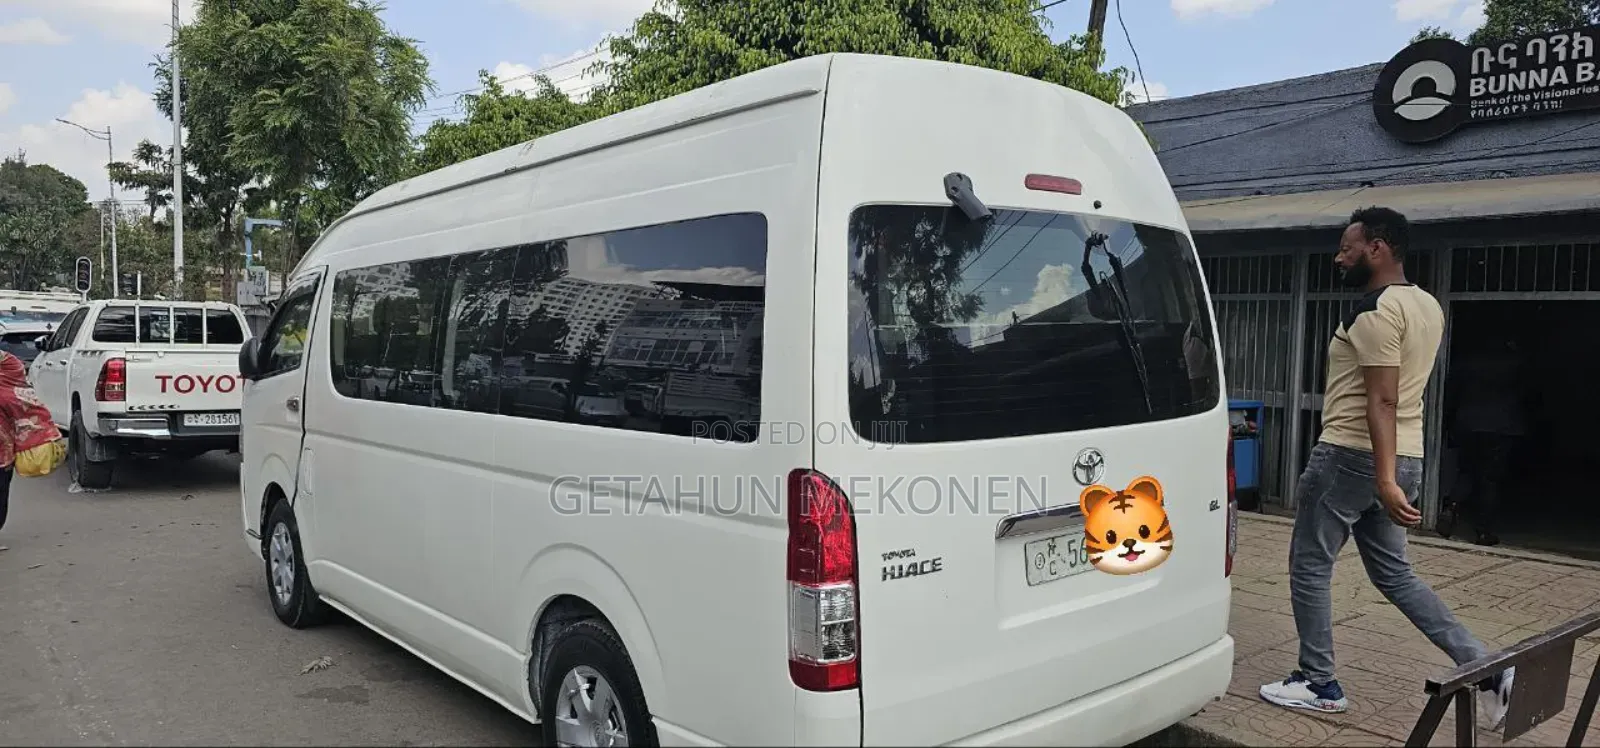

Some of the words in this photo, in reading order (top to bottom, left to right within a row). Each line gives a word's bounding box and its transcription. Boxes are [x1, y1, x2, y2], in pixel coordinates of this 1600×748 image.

[1470, 43, 1517, 75] ቡና
[1526, 31, 1593, 65] ባንክ
[1469, 65, 1569, 97] BUNNA
[1575, 61, 1600, 84] B
[1470, 97, 1497, 108] Bank
[1499, 95, 1511, 105] of
[1513, 93, 1531, 103] the
[1533, 85, 1600, 100] Visionaries
[881, 548, 916, 561] TOYOTA
[881, 556, 943, 581] HIACE
